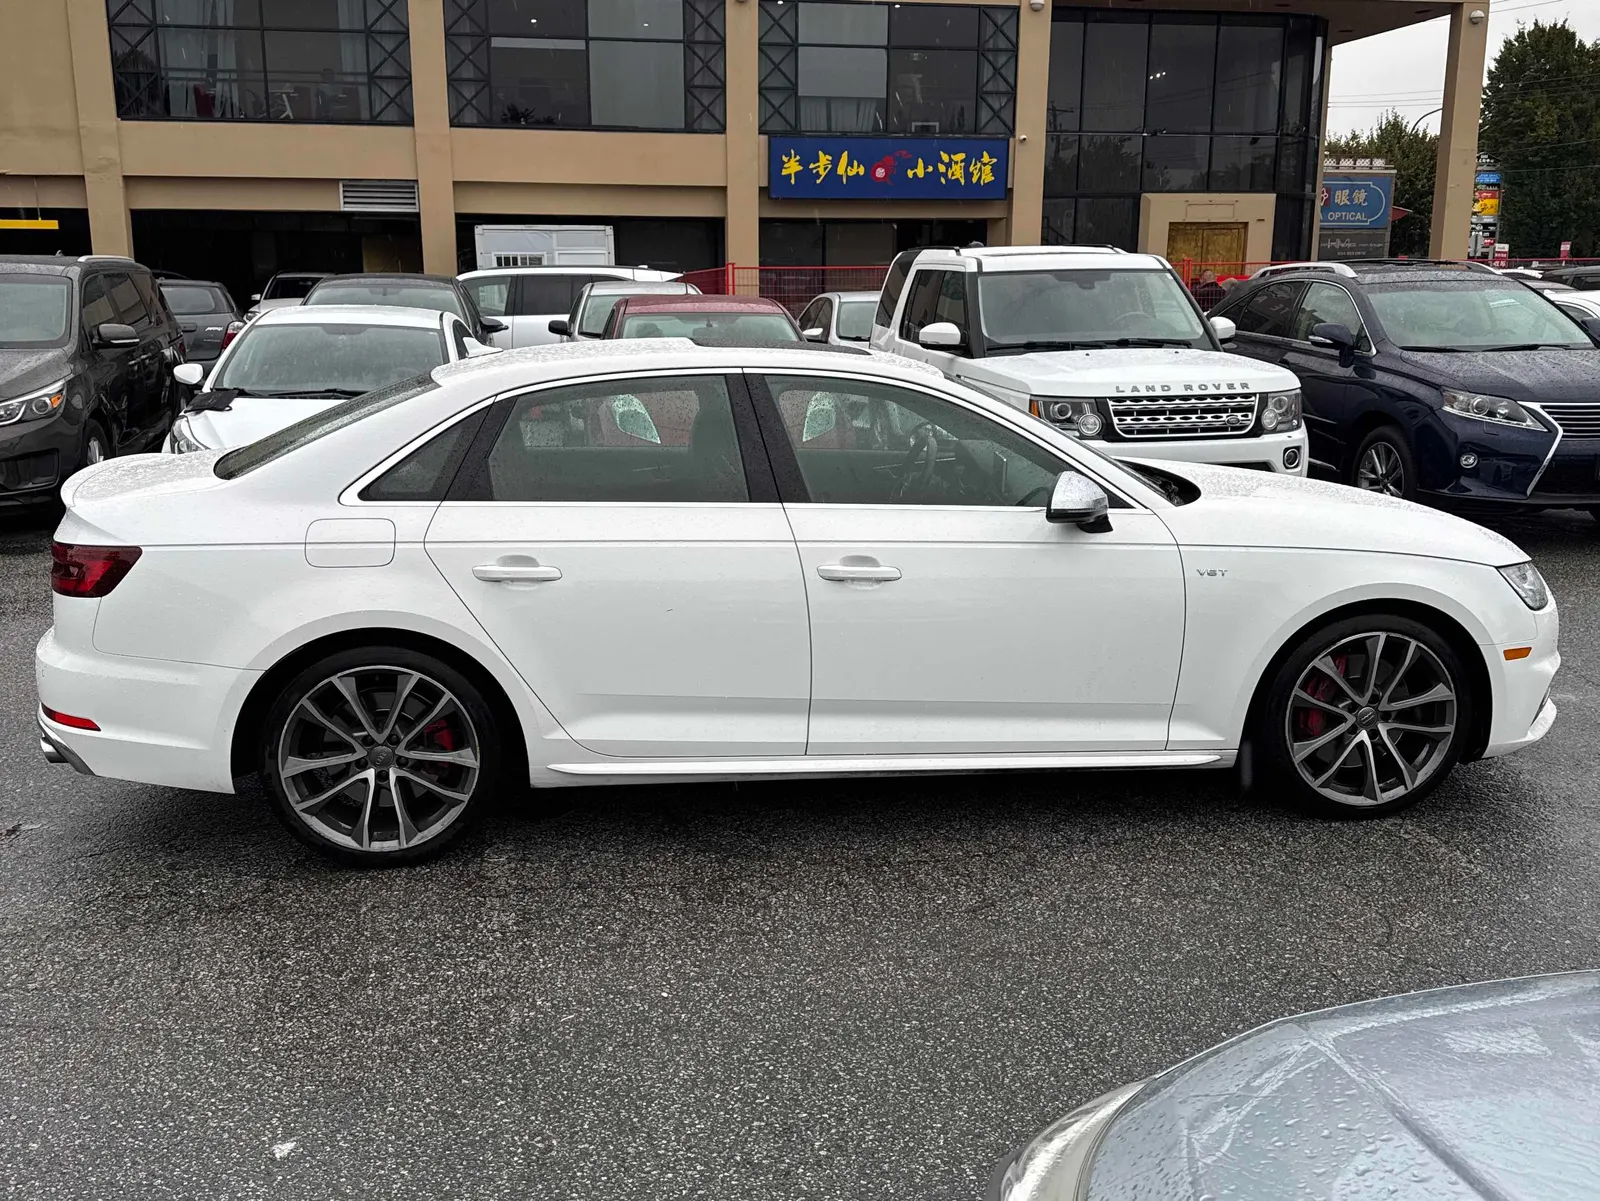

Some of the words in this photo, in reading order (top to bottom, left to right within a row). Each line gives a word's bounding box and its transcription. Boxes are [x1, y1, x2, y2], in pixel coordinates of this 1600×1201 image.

[780, 149, 865, 185] 半步仙
[1334, 188, 1368, 206] 眼鏡
[1327, 211, 1368, 221] OPTICAL
[1115, 384, 1172, 393] LAND
[1183, 382, 1251, 392] ROVER
